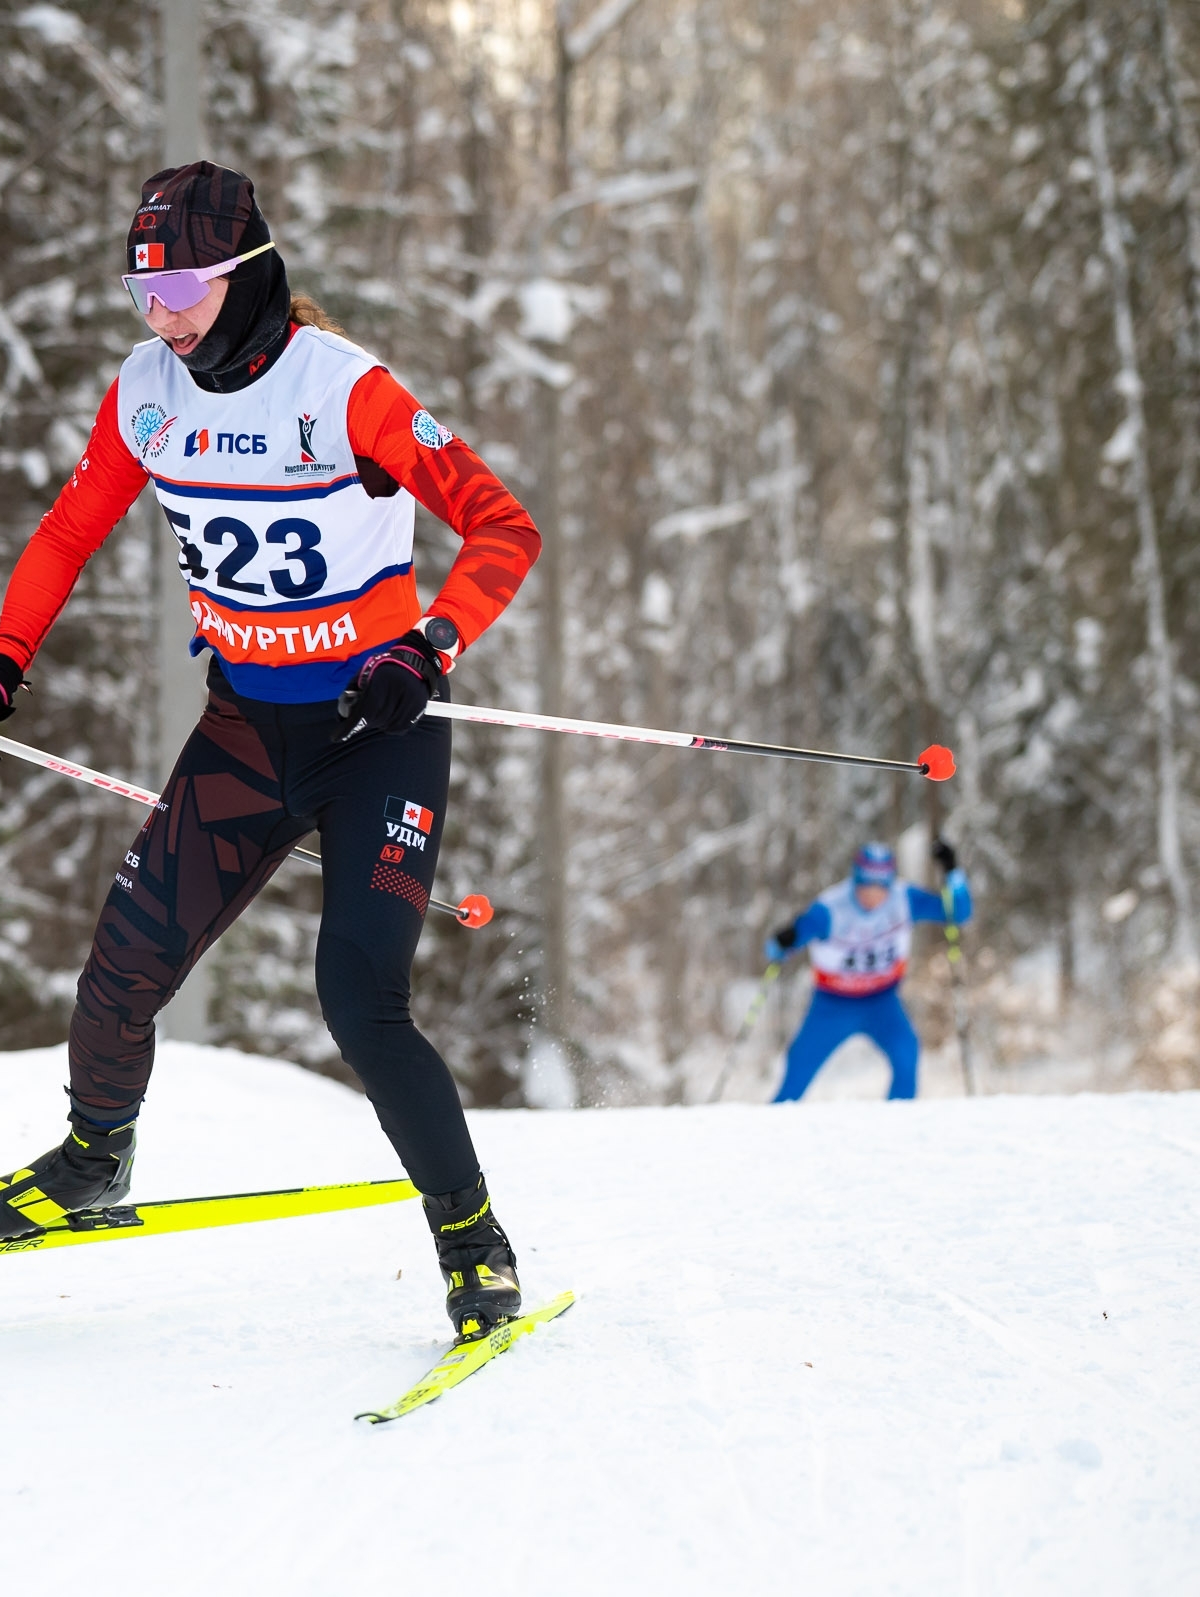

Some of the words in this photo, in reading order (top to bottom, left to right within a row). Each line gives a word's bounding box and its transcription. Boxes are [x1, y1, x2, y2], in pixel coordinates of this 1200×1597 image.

[216, 433, 267, 455] ПСБ
[386, 822, 427, 851] УДМ
[124, 849, 141, 868] СБ
[489, 1328, 513, 1353] FISCHER
